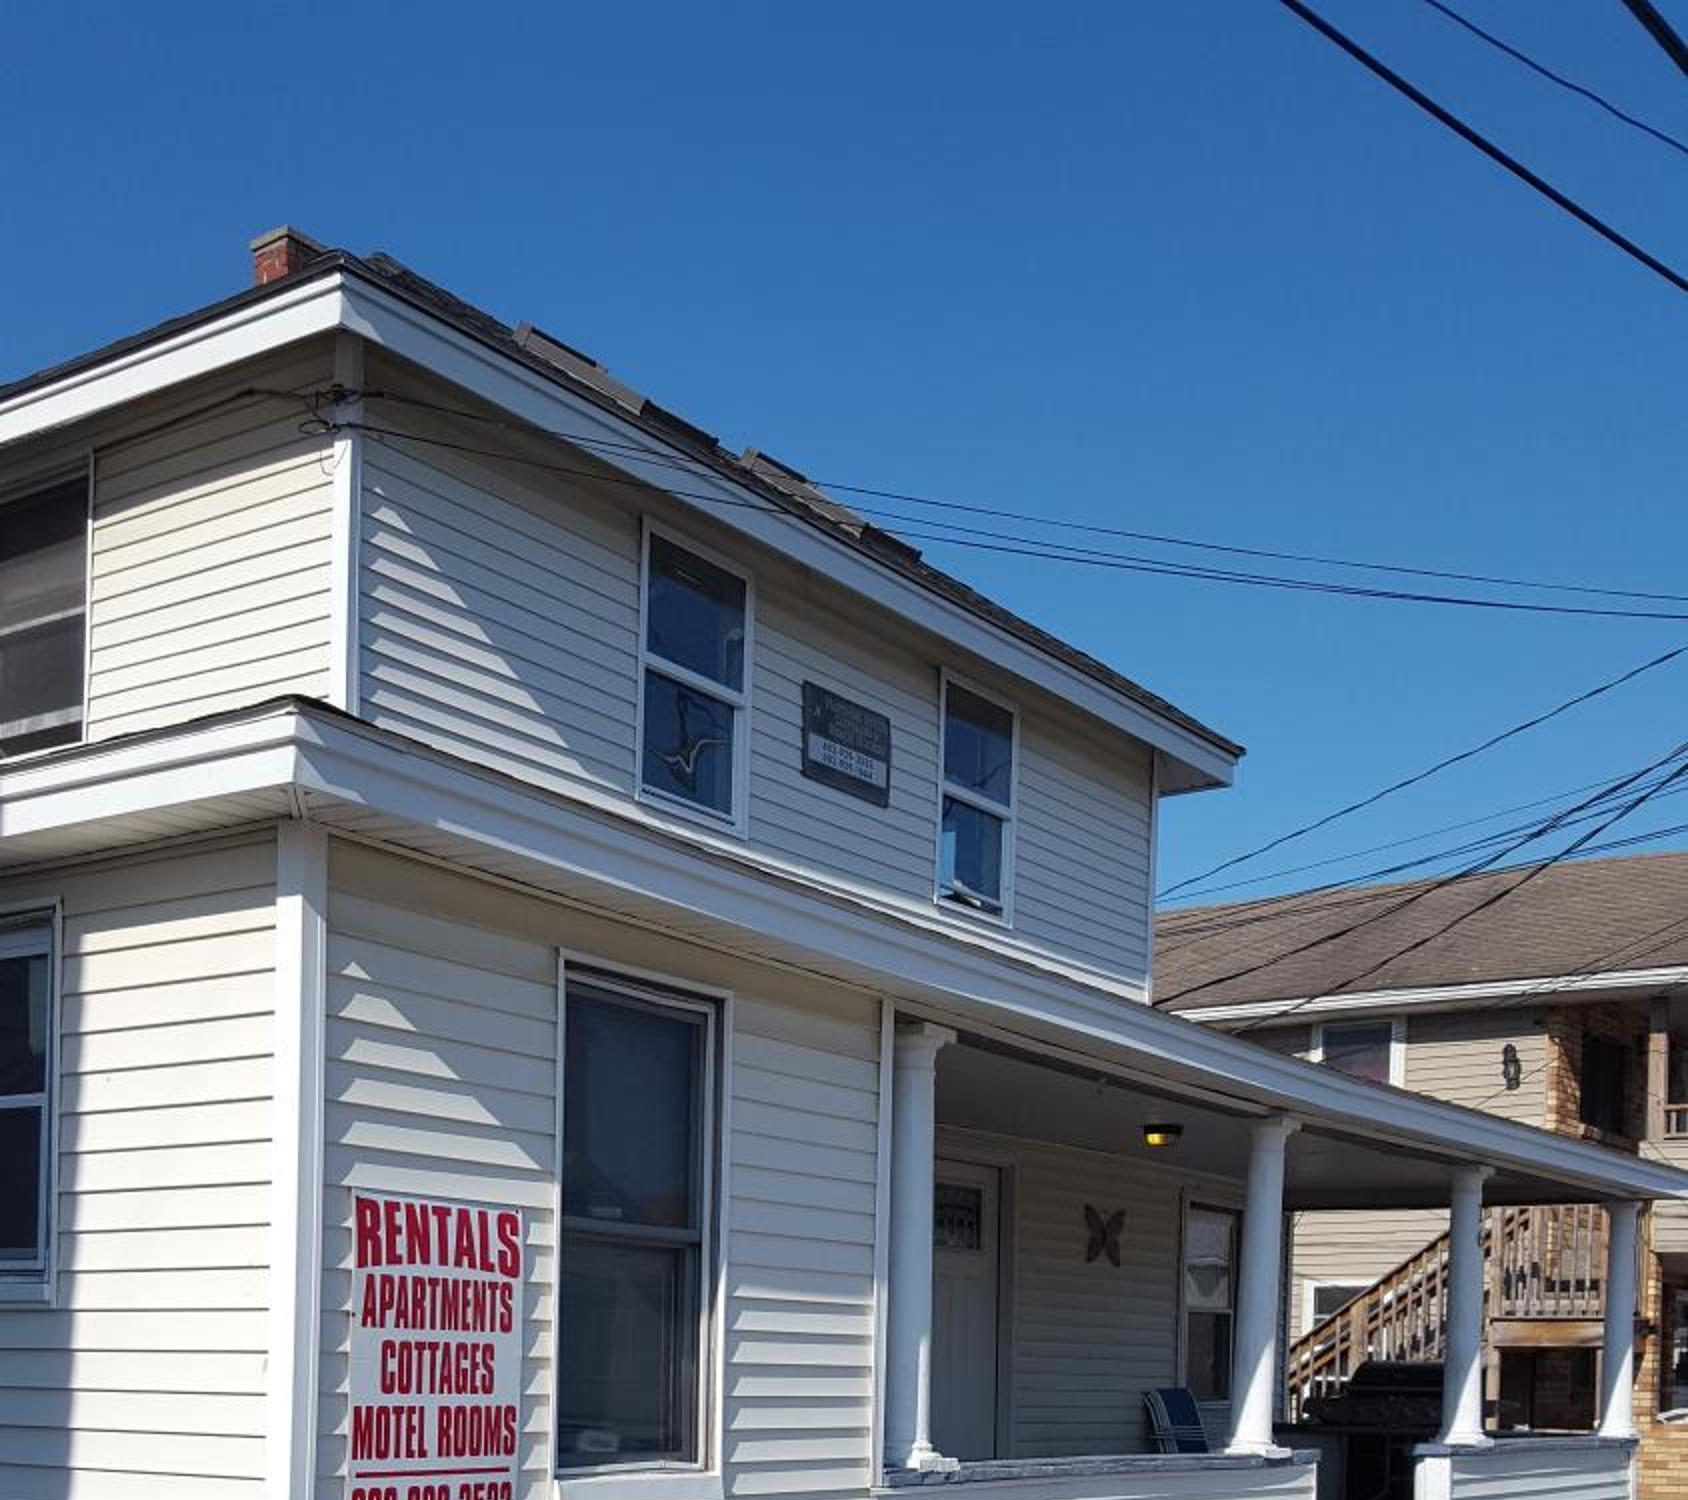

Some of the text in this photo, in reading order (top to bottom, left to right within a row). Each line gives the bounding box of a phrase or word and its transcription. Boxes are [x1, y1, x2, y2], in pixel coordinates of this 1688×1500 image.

[355, 1197, 520, 1278] RENTALS
[361, 1273, 513, 1333] APARTMENTS
[380, 1340, 495, 1395] COTTAGES
[351, 1405, 517, 1460] MOTEL ROOMS
